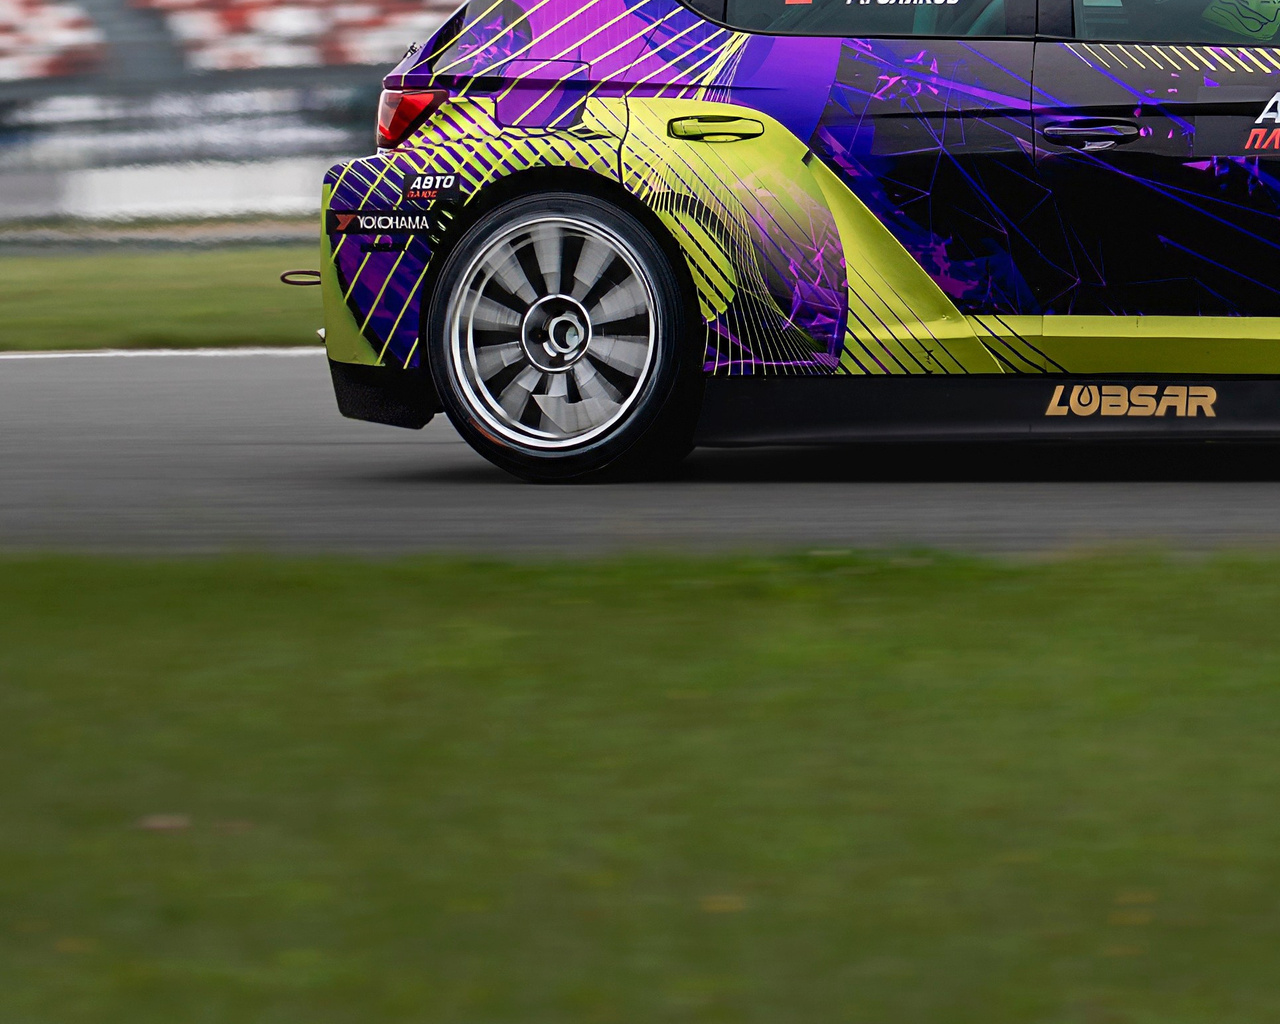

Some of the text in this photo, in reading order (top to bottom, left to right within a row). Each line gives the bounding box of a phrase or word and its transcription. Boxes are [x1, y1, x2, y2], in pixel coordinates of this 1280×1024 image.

[410, 175, 455, 190] АВТО
[357, 215, 430, 230] YOKOHAMA
[1044, 384, 1217, 418] LUBSAR
